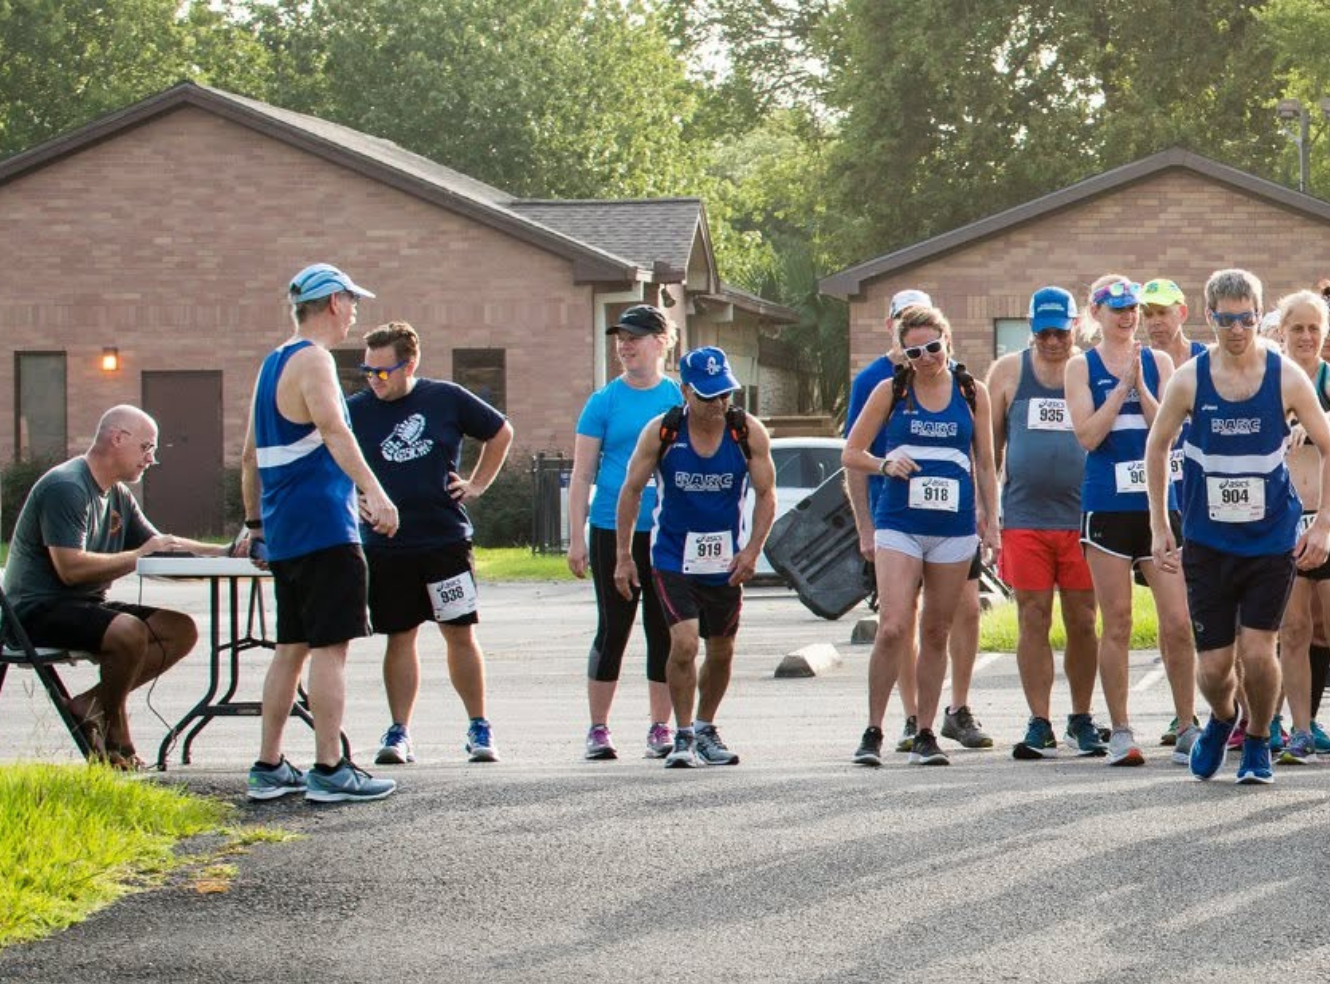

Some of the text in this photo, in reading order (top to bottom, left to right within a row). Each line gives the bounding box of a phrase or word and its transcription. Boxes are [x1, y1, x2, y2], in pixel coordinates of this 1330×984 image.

[1040, 408, 1064, 422] 935
[923, 487, 949, 501] 918
[1222, 489, 1250, 504] 904
[697, 543, 722, 557] 919
[440, 586, 464, 603] 938
